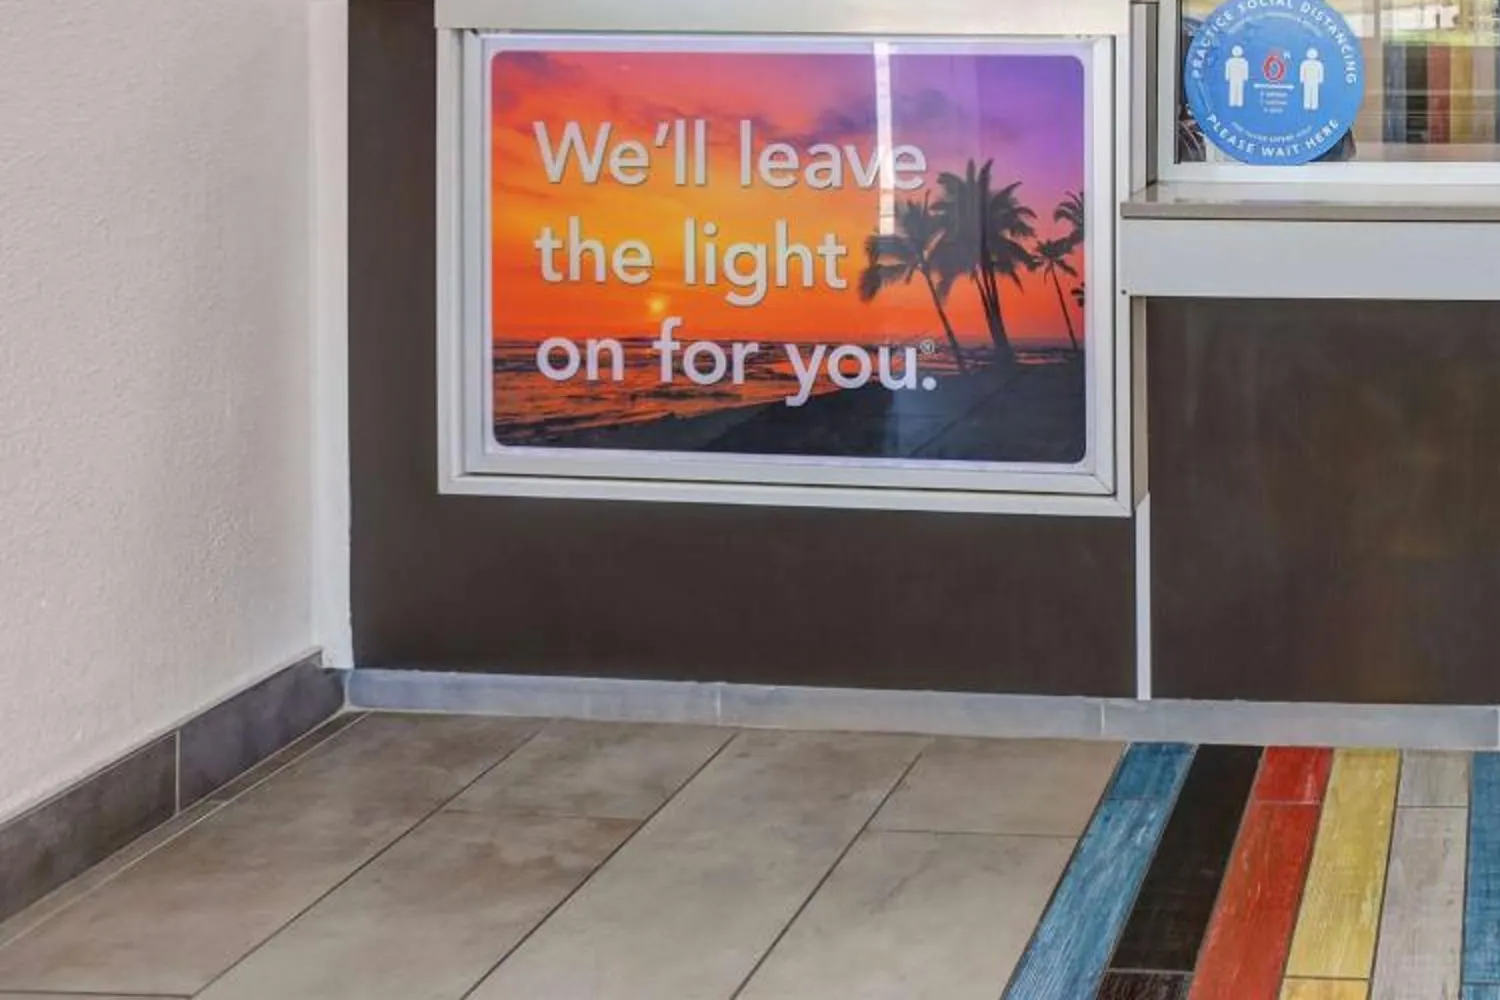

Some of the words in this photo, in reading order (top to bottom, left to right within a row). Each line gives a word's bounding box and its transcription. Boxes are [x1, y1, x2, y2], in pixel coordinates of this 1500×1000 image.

[1191, 9, 1235, 79] PRACTICE
[1299, 1, 1358, 85] DISTANCING
[532, 118, 707, 187] We'll
[739, 118, 928, 190] leave
[1207, 113, 1257, 154] PLEASE
[1261, 145, 1301, 158] WAIT
[1305, 118, 1340, 150] HERE
[533, 216, 655, 285] the
[683, 216, 849, 307] light
[536, 335, 623, 382] on
[652, 315, 759, 386] for
